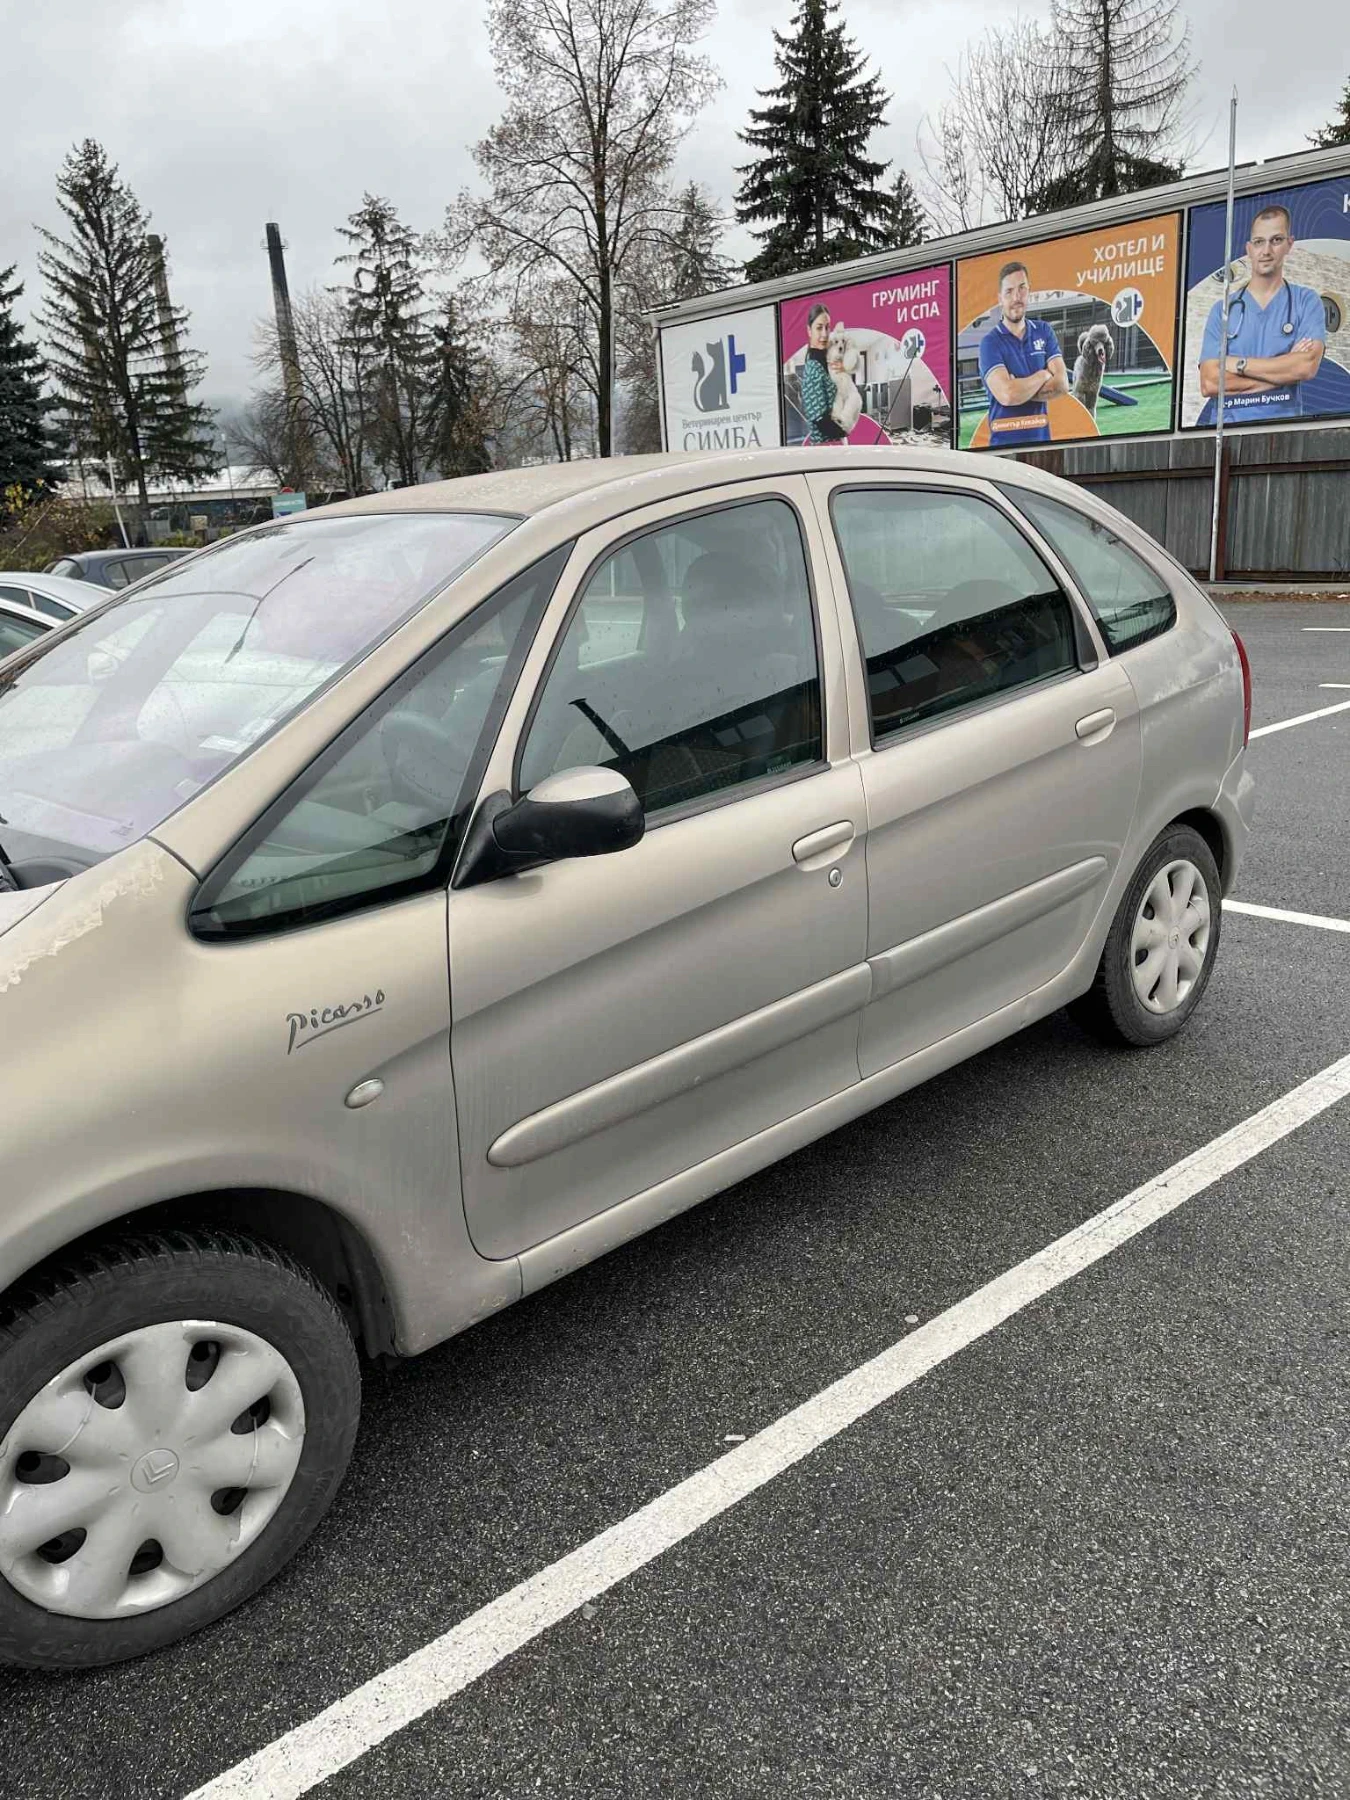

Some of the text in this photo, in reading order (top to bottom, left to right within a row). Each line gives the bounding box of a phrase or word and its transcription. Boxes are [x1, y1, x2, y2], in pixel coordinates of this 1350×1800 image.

[1093, 233, 1165, 263] ХОТЕЛ И
[1076, 255, 1165, 287] УЧИЛИЩЕ
[872, 280, 940, 308] ГРУМИНГ
[897, 301, 940, 323] И СПА
[1233, 397, 1260, 406] Марин
[1261, 393, 1290, 404] Бучков
[683, 424, 762, 452] СИМБА
[286, 989, 385, 1055] Picasso
